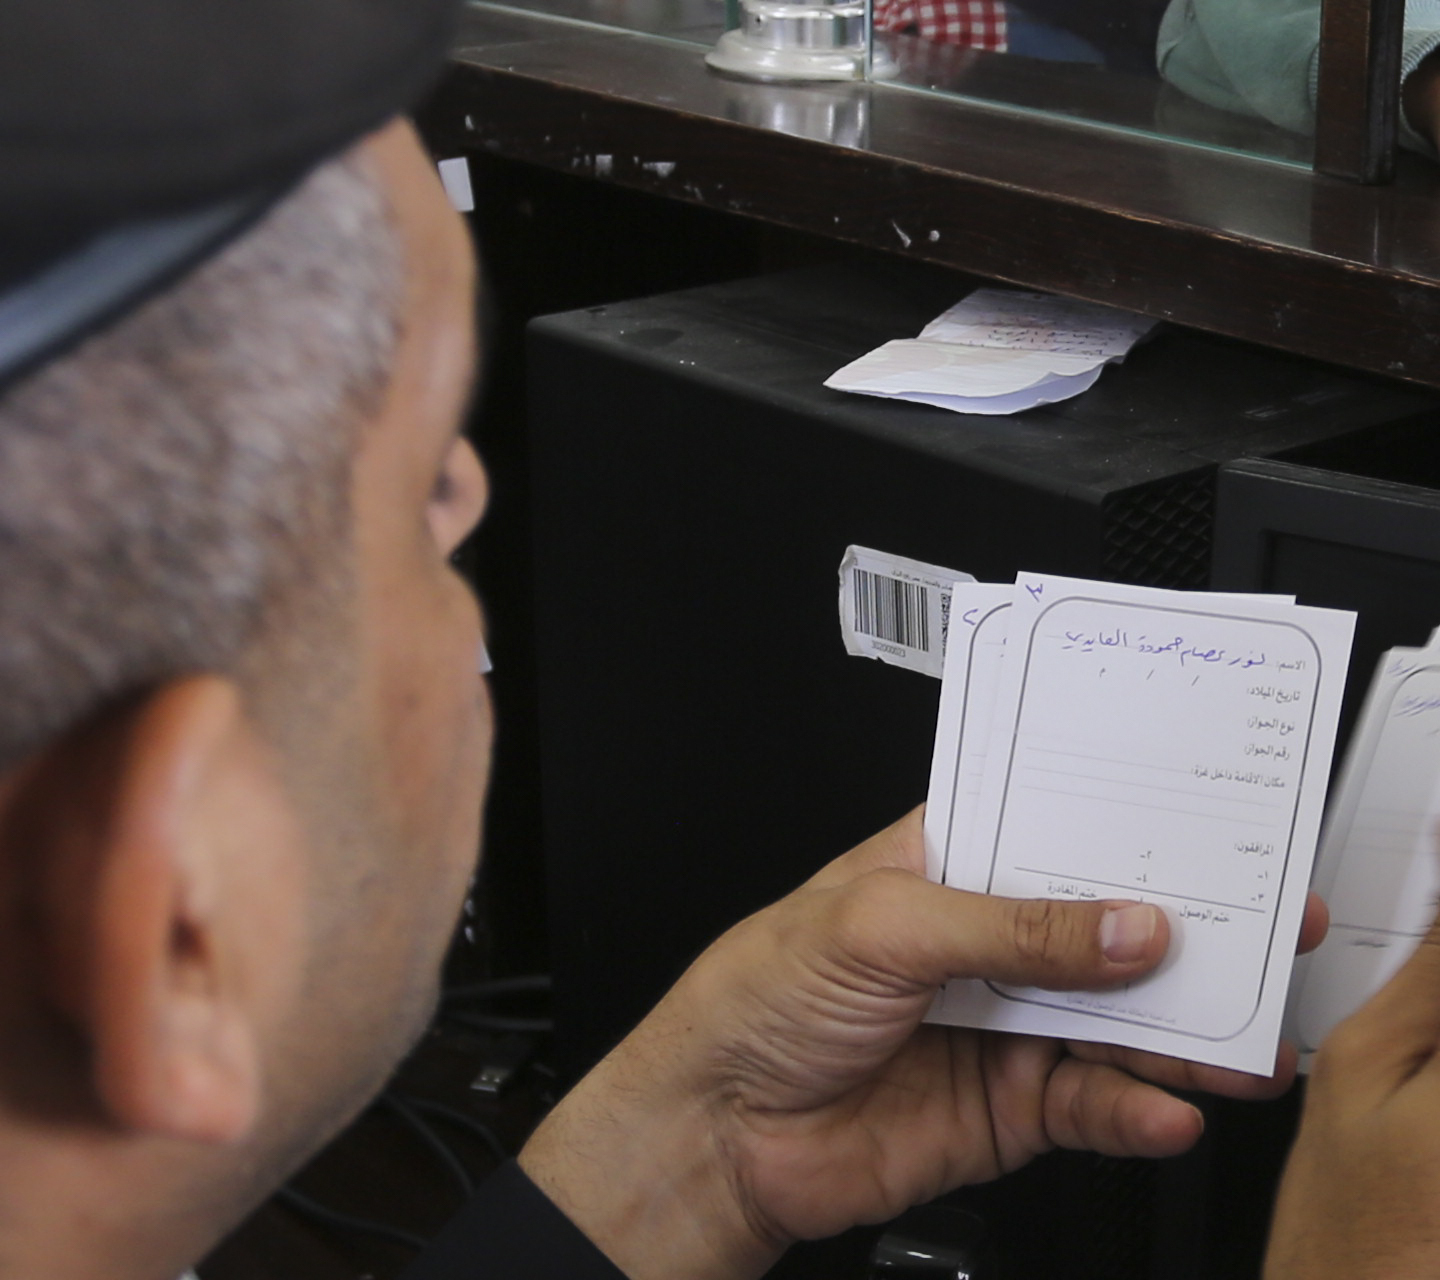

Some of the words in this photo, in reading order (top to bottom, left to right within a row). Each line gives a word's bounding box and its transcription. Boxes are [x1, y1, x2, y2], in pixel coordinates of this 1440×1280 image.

[1279, 721, 1295, 736] نوع
[1273, 746, 1290, 761] رقم
[1210, 769, 1233, 781] داخل
[1264, 777, 1286, 788] مكان
[1179, 905, 1212, 922] الوصول
